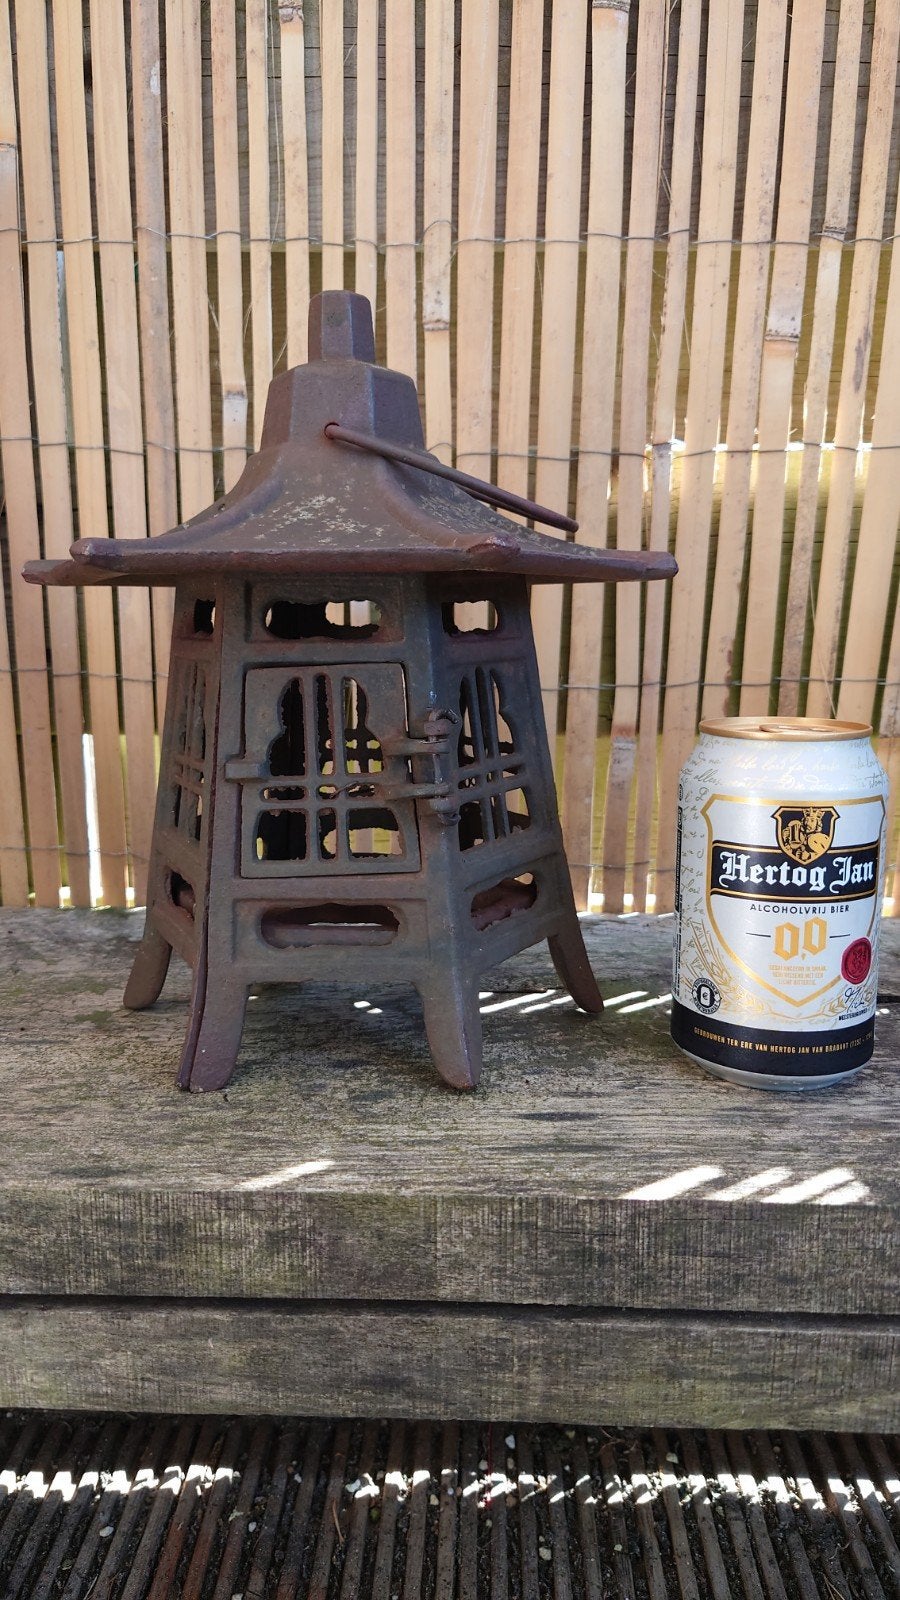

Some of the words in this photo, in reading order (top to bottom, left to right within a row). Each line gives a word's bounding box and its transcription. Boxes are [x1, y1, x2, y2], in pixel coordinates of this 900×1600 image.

[719, 851, 827, 891] Hertog
[829, 856, 874, 893] Jan
[750, 903, 826, 914] ALCOHOLVRIJ
[830, 904, 850, 913] BIER
[727, 1037, 738, 1047] TER
[740, 1040, 753, 1050] ERE
[755, 1043, 768, 1052] VAN
[770, 1045, 796, 1054] HERTOG
[798, 1046, 809, 1054] JAN
